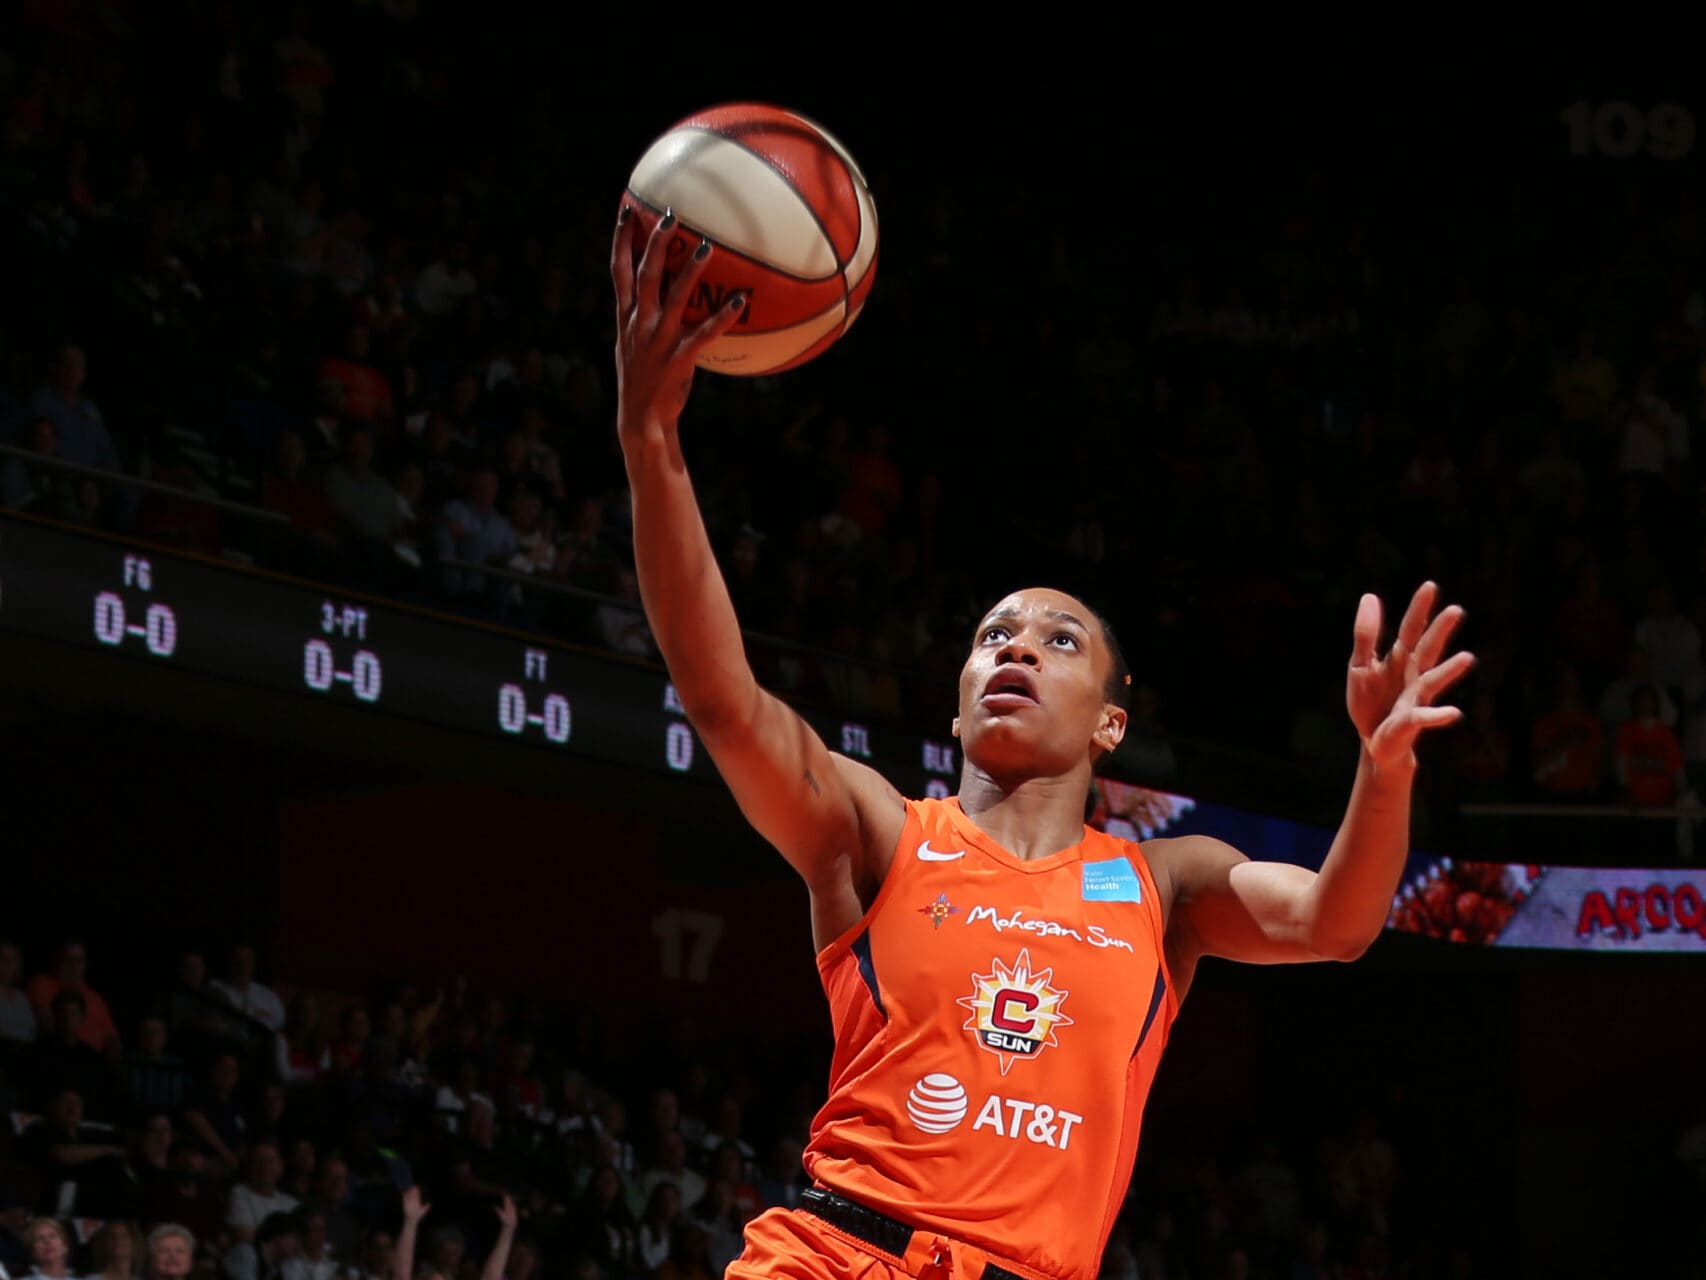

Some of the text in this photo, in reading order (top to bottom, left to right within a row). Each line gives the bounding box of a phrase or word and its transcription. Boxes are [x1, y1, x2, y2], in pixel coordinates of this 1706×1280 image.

[1558, 99, 1697, 161] 109
[122, 553, 153, 592] FG
[93, 589, 178, 658] 0-0
[319, 598, 370, 641] 3-PT
[303, 637, 383, 702] 0-0
[524, 645, 549, 683] FT
[497, 681, 572, 744] 0-0
[840, 721, 873, 759] STL
[922, 740, 957, 776] BLK
[1085, 882, 1120, 891] Health
[650, 907, 725, 985] 17
[966, 905, 1135, 953] Mohegan Sun
[985, 1031, 1033, 1054] SUN
[972, 1094, 1083, 1151] AT&T
